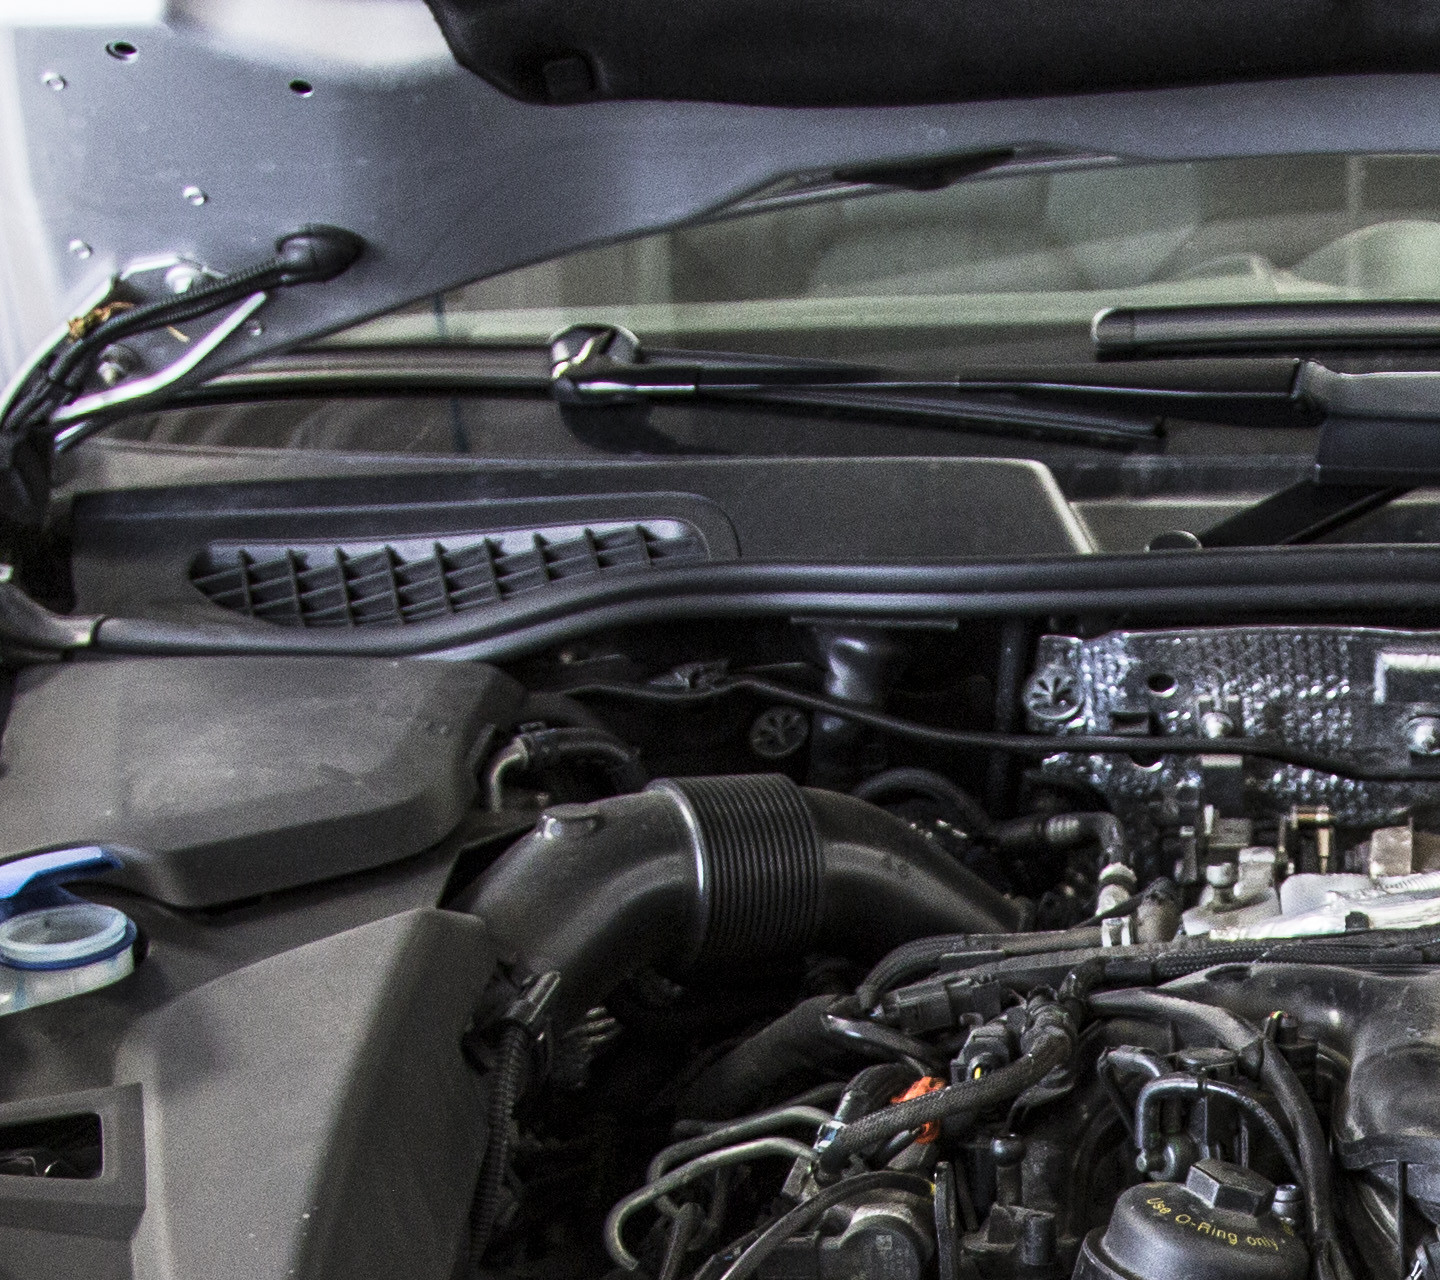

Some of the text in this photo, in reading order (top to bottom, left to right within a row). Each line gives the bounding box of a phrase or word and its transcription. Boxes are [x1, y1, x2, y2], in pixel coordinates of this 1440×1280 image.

[1146, 1197, 1279, 1251] Use O-Ring only
